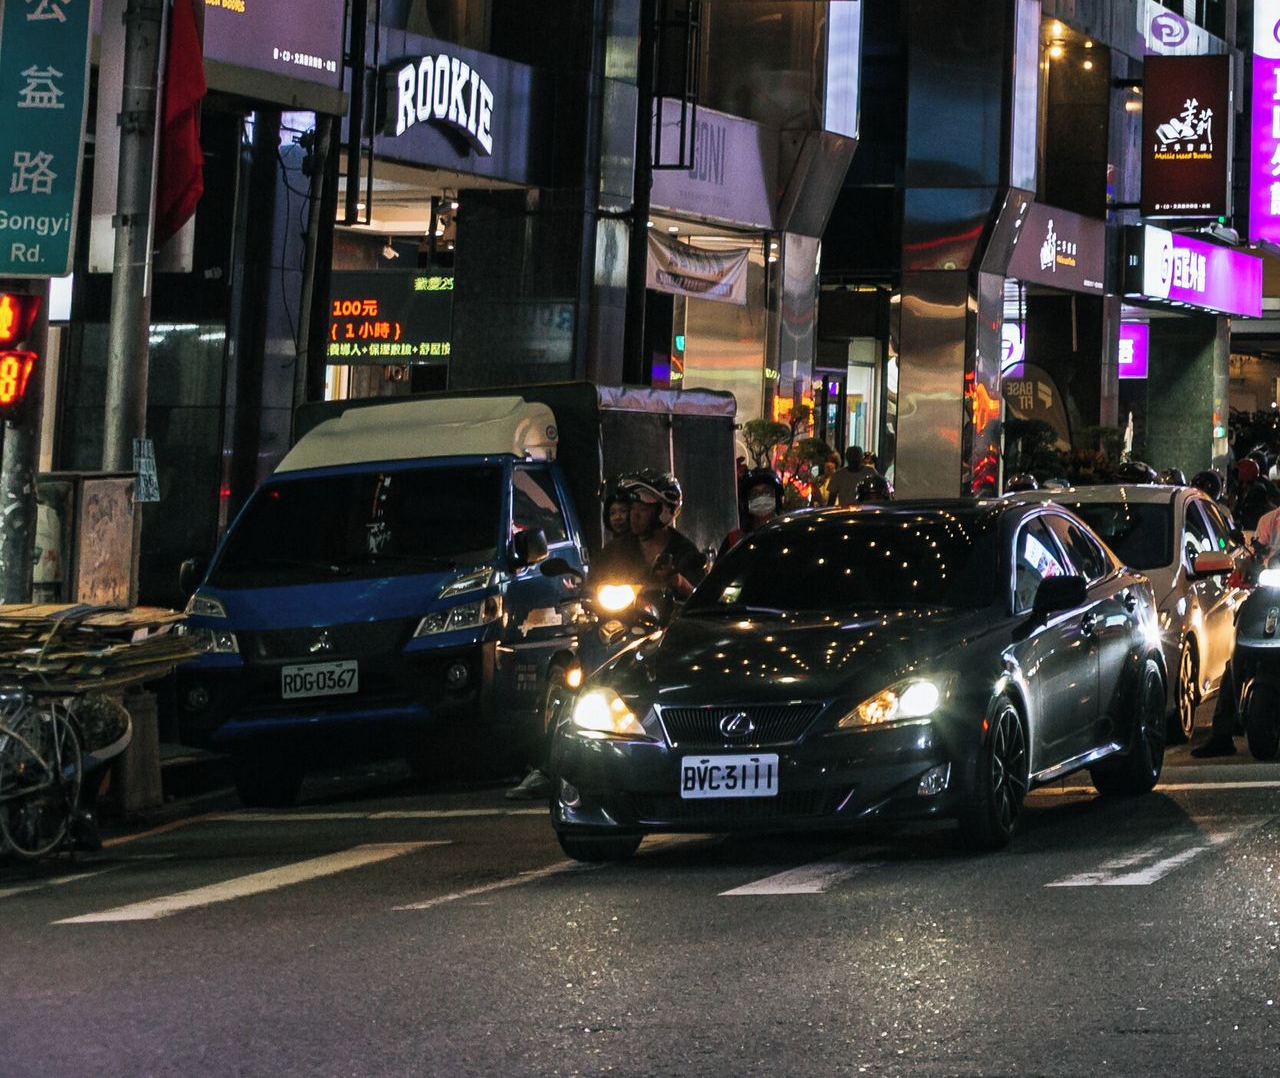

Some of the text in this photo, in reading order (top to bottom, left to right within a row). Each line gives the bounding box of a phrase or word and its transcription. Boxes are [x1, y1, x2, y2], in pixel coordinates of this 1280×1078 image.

[396, 54, 494, 155] ROOKIE
[10, 243, 46, 263] Rd.
[333, 300, 378, 316] 100元
